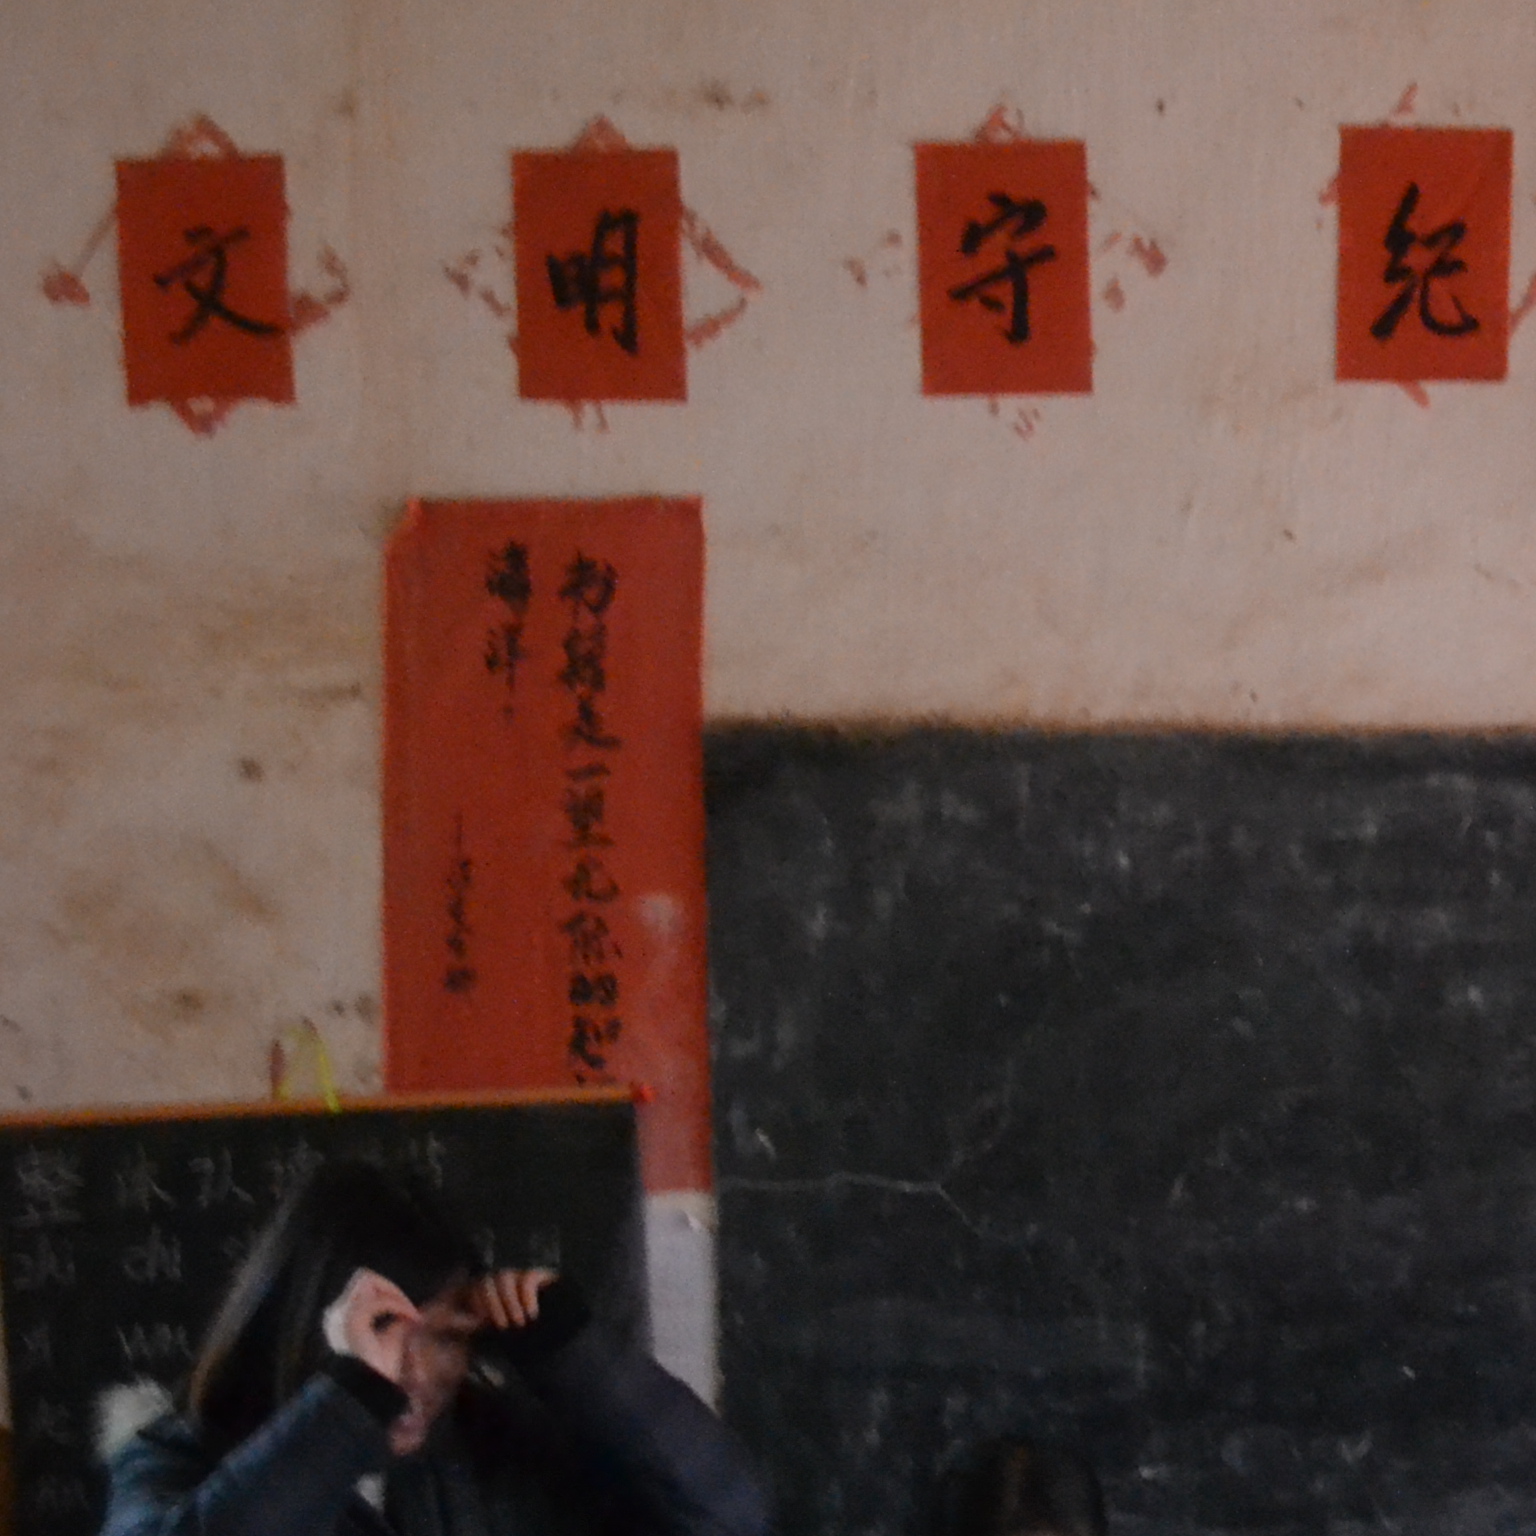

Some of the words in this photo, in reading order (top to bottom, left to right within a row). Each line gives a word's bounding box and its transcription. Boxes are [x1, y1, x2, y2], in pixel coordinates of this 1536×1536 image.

[153, 224, 286, 347] 文
[545, 207, 640, 358] 明
[947, 192, 1056, 345] 守
[1370, 182, 1479, 342] 纪
